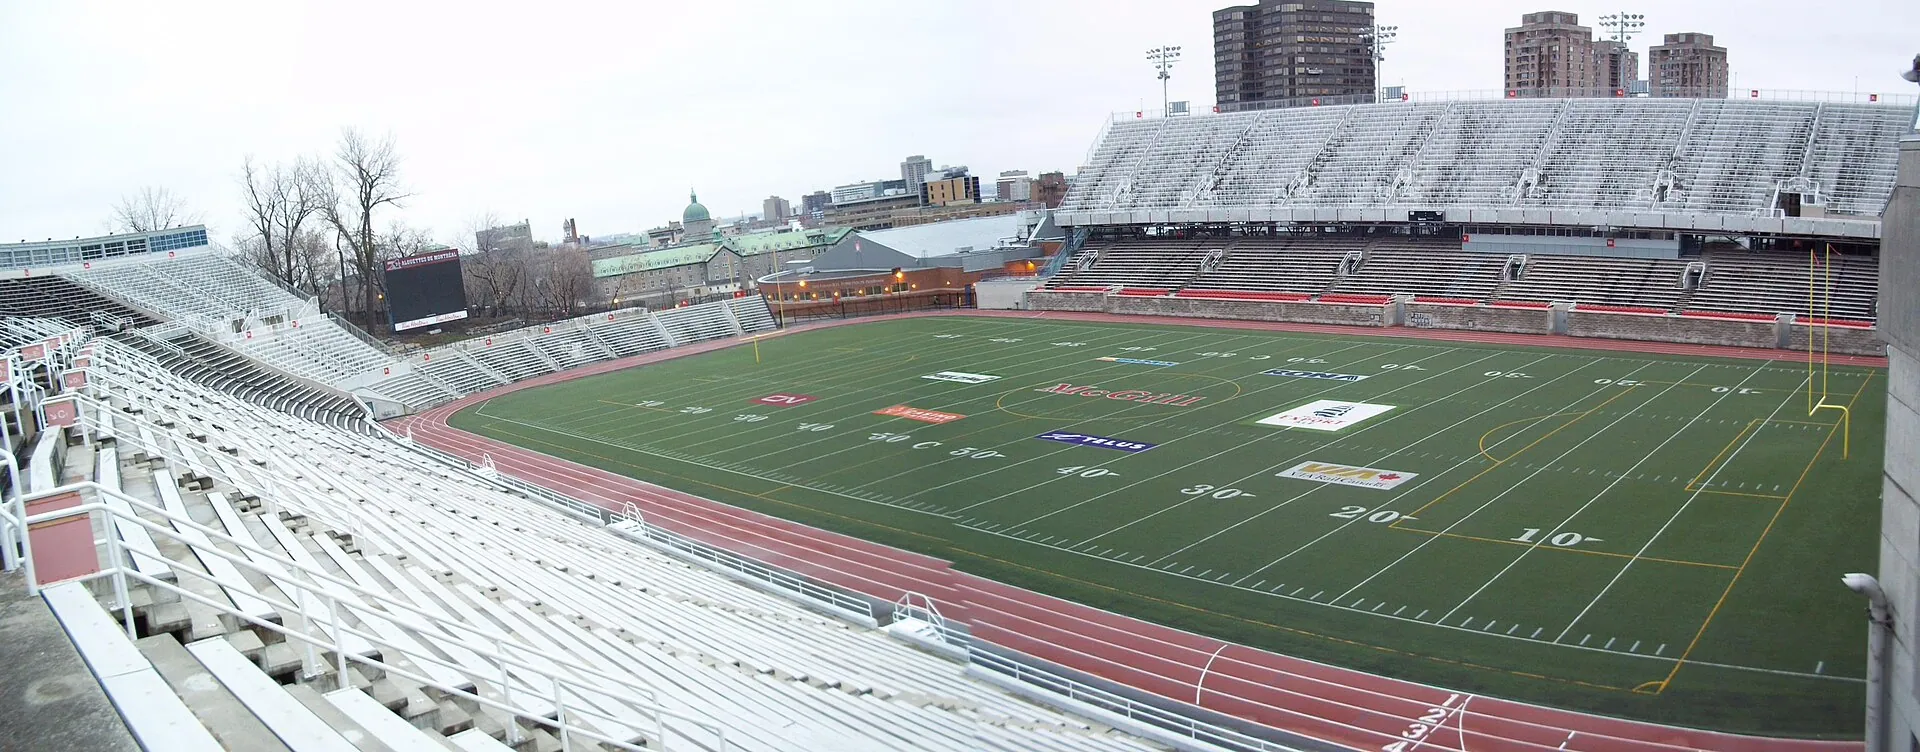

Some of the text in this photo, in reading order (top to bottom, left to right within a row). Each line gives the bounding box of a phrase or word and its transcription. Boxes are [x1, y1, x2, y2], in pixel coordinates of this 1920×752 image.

[1263, 369, 1359, 382] RONA
[760, 395, 807, 404] CN
[1034, 383, 1208, 406] McGill
[1278, 414, 1346, 425] EXPORT
[868, 432, 911, 443] 50
[1082, 436, 1147, 450] TELUS
[912, 441, 943, 449] C
[949, 447, 998, 459] 50
[1057, 465, 1109, 478] 40
[1180, 484, 1243, 500] 30
[1329, 505, 1400, 523] 20
[1510, 527, 1583, 547] 10
[1442, 694, 1459, 706] 1
[1418, 708, 1447, 723] 2
[1402, 723, 1428, 740] 3
